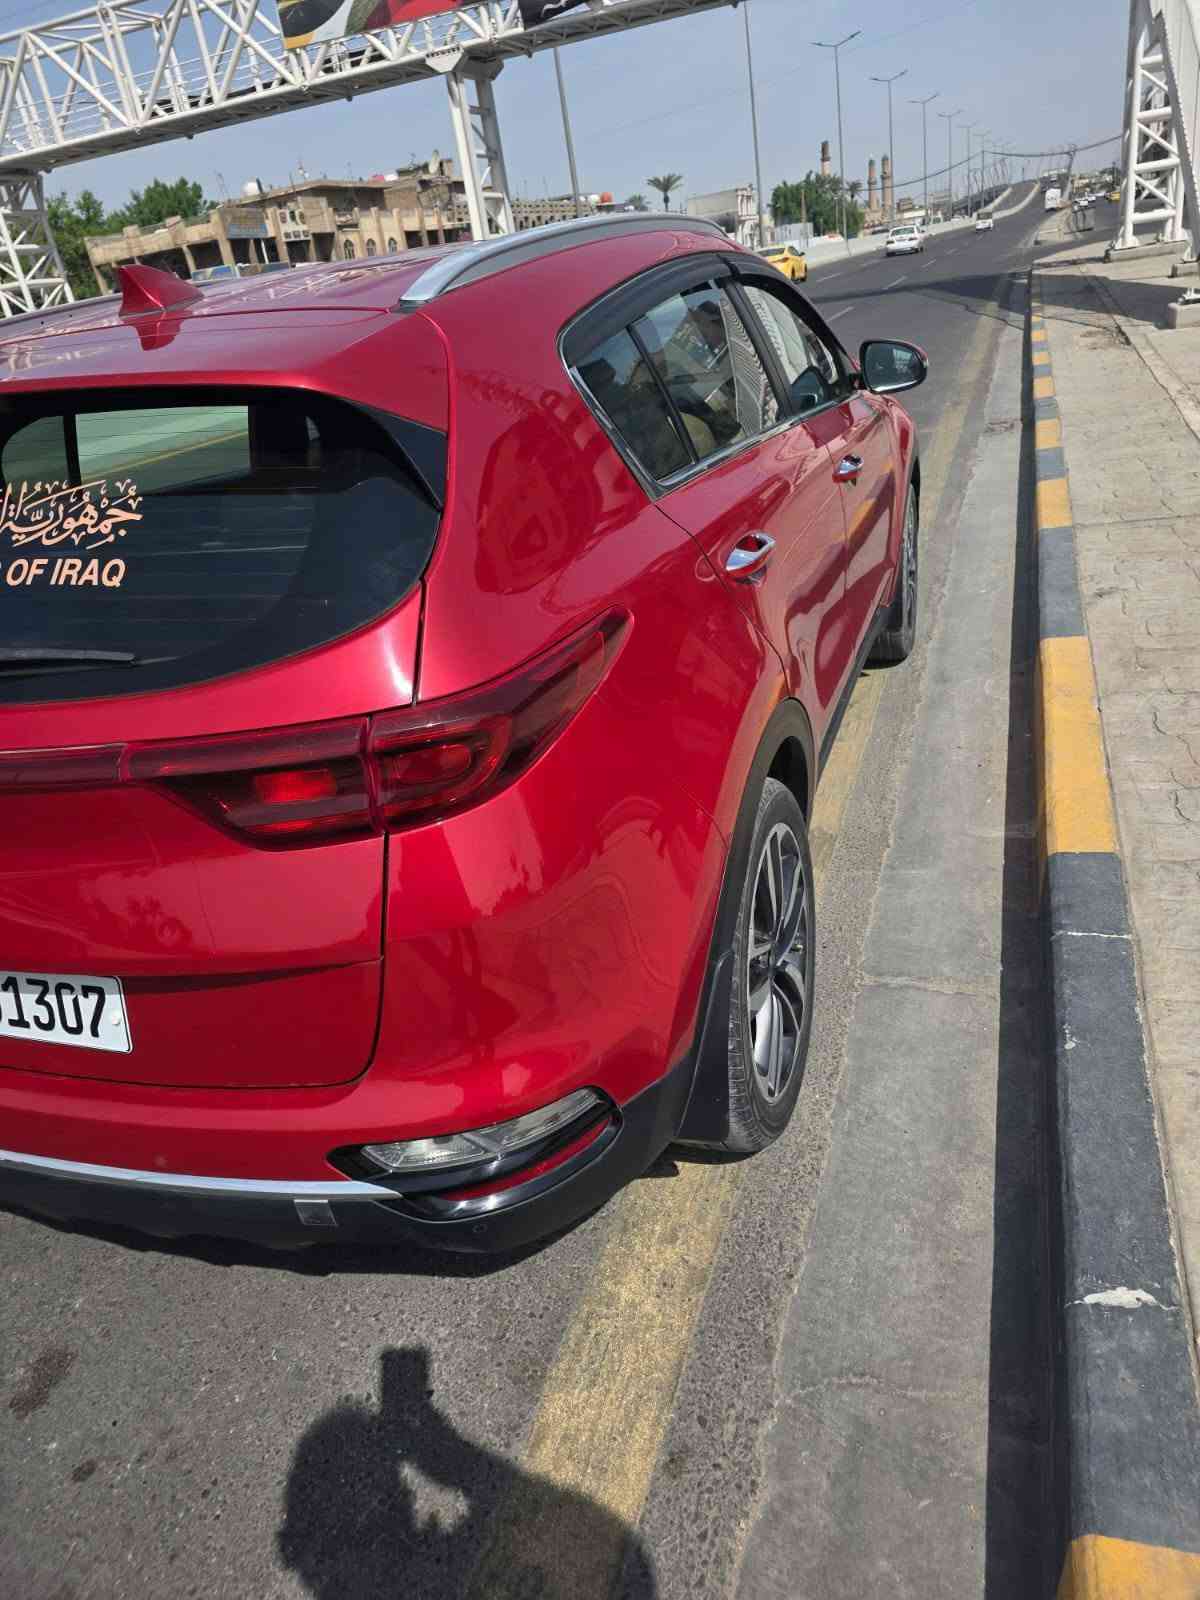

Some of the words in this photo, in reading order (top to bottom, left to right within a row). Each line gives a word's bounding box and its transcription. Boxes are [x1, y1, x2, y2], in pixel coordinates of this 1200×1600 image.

[6, 558, 48, 586] OF
[50, 558, 126, 587] IRAQ
[0, 976, 106, 1038] 1307
